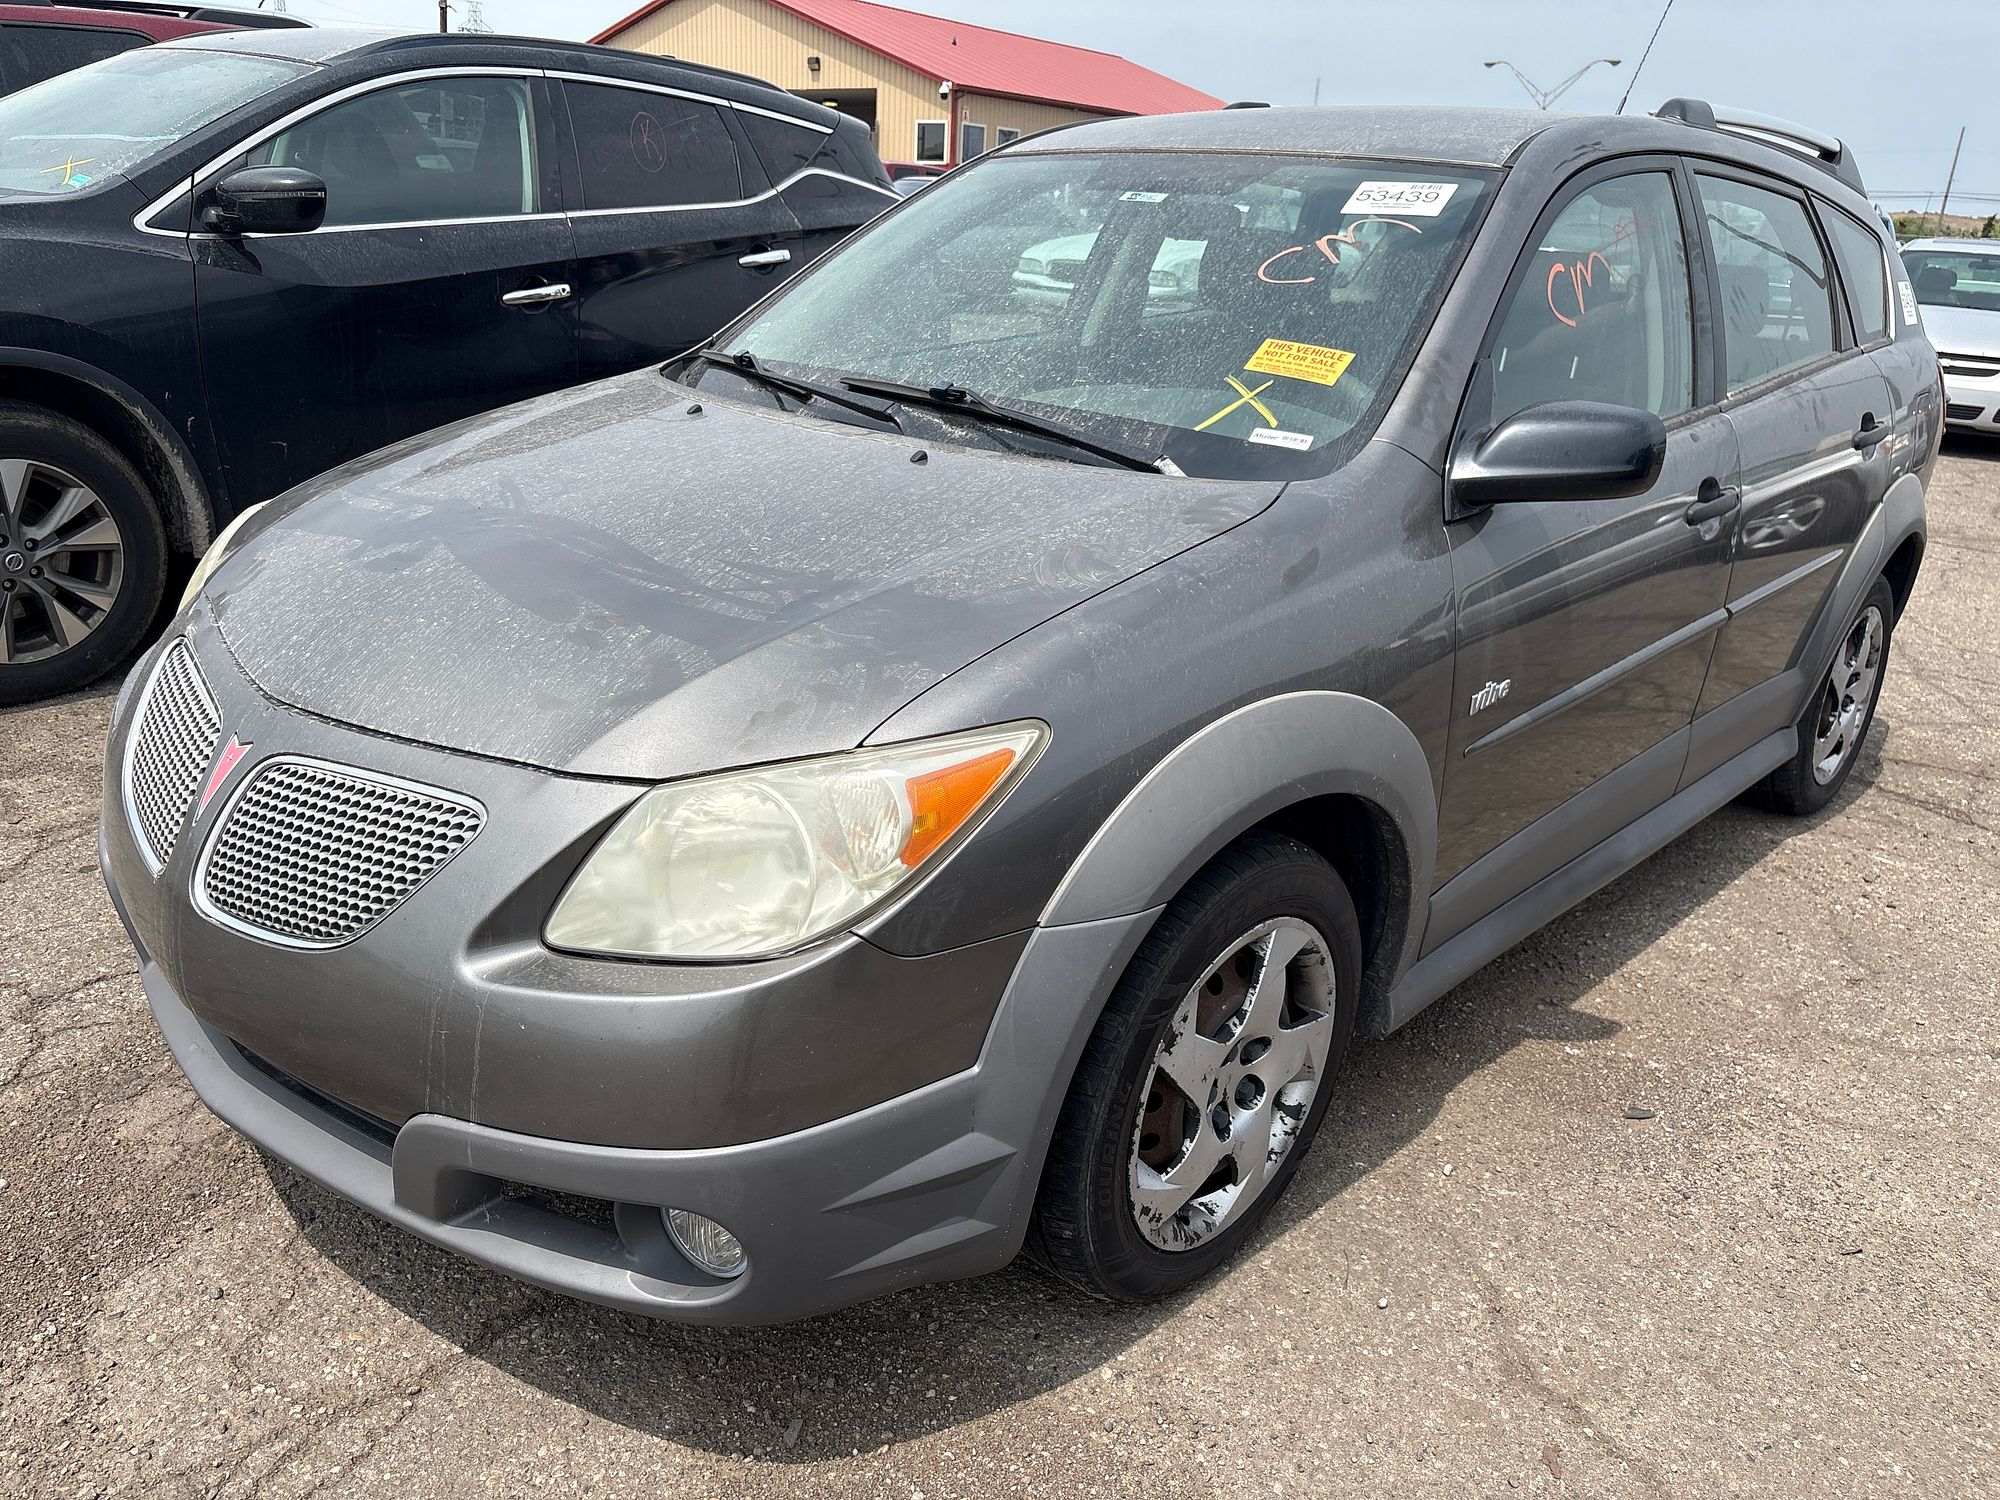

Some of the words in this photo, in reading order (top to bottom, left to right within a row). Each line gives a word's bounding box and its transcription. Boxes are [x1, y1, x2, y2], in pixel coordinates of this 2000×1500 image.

[1356, 189, 1440, 203] 53439
[1263, 349, 1285, 358] NOT
[1286, 353, 1308, 362] FOR
[1310, 357, 1338, 368] SALE
[1267, 341, 1294, 352] THIS
[1297, 345, 1347, 362] VEHICLE
